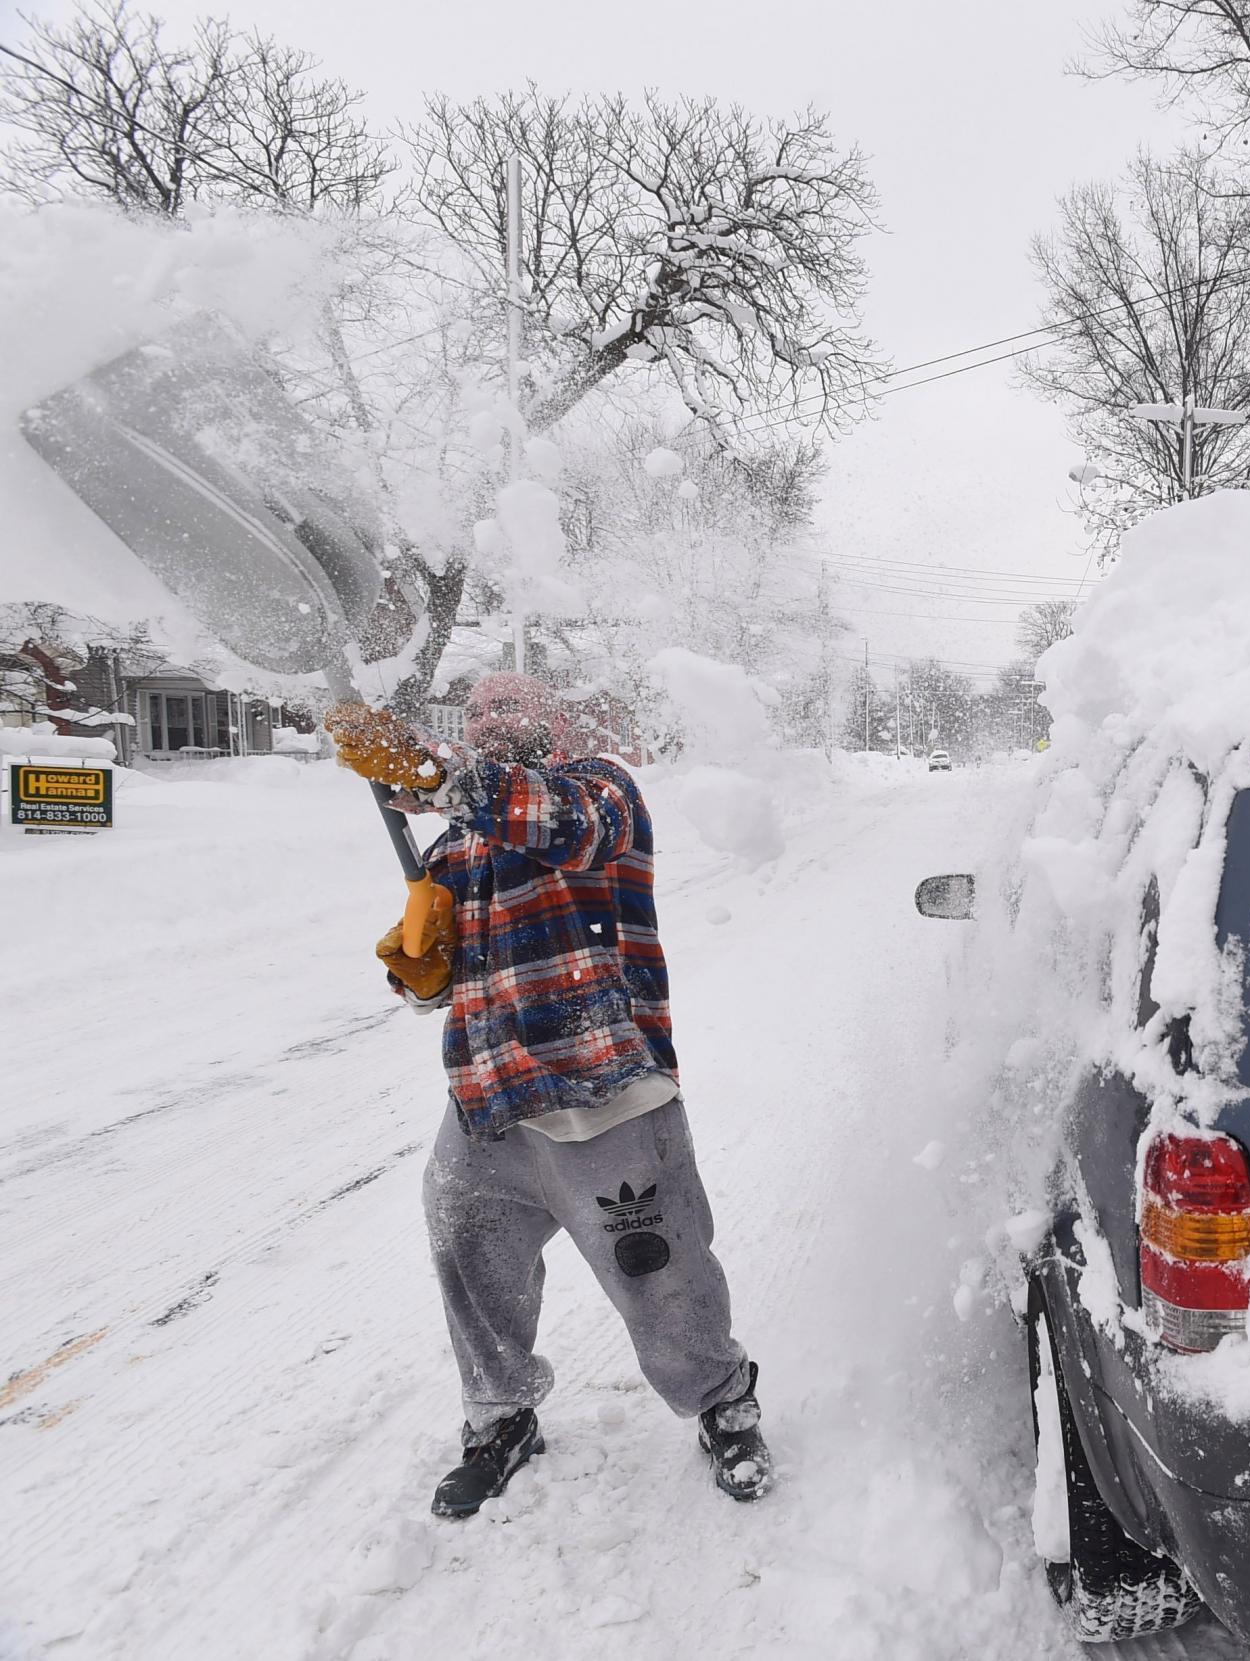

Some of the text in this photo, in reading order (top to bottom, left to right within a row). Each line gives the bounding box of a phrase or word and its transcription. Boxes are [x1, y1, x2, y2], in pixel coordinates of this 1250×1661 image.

[28, 774, 96, 785] Howard
[28, 786, 88, 797] Hanna
[20, 802, 104, 813] Real Estate Services
[17, 810, 107, 822] 814-833-1000
[604, 1214, 663, 1232] adidas
